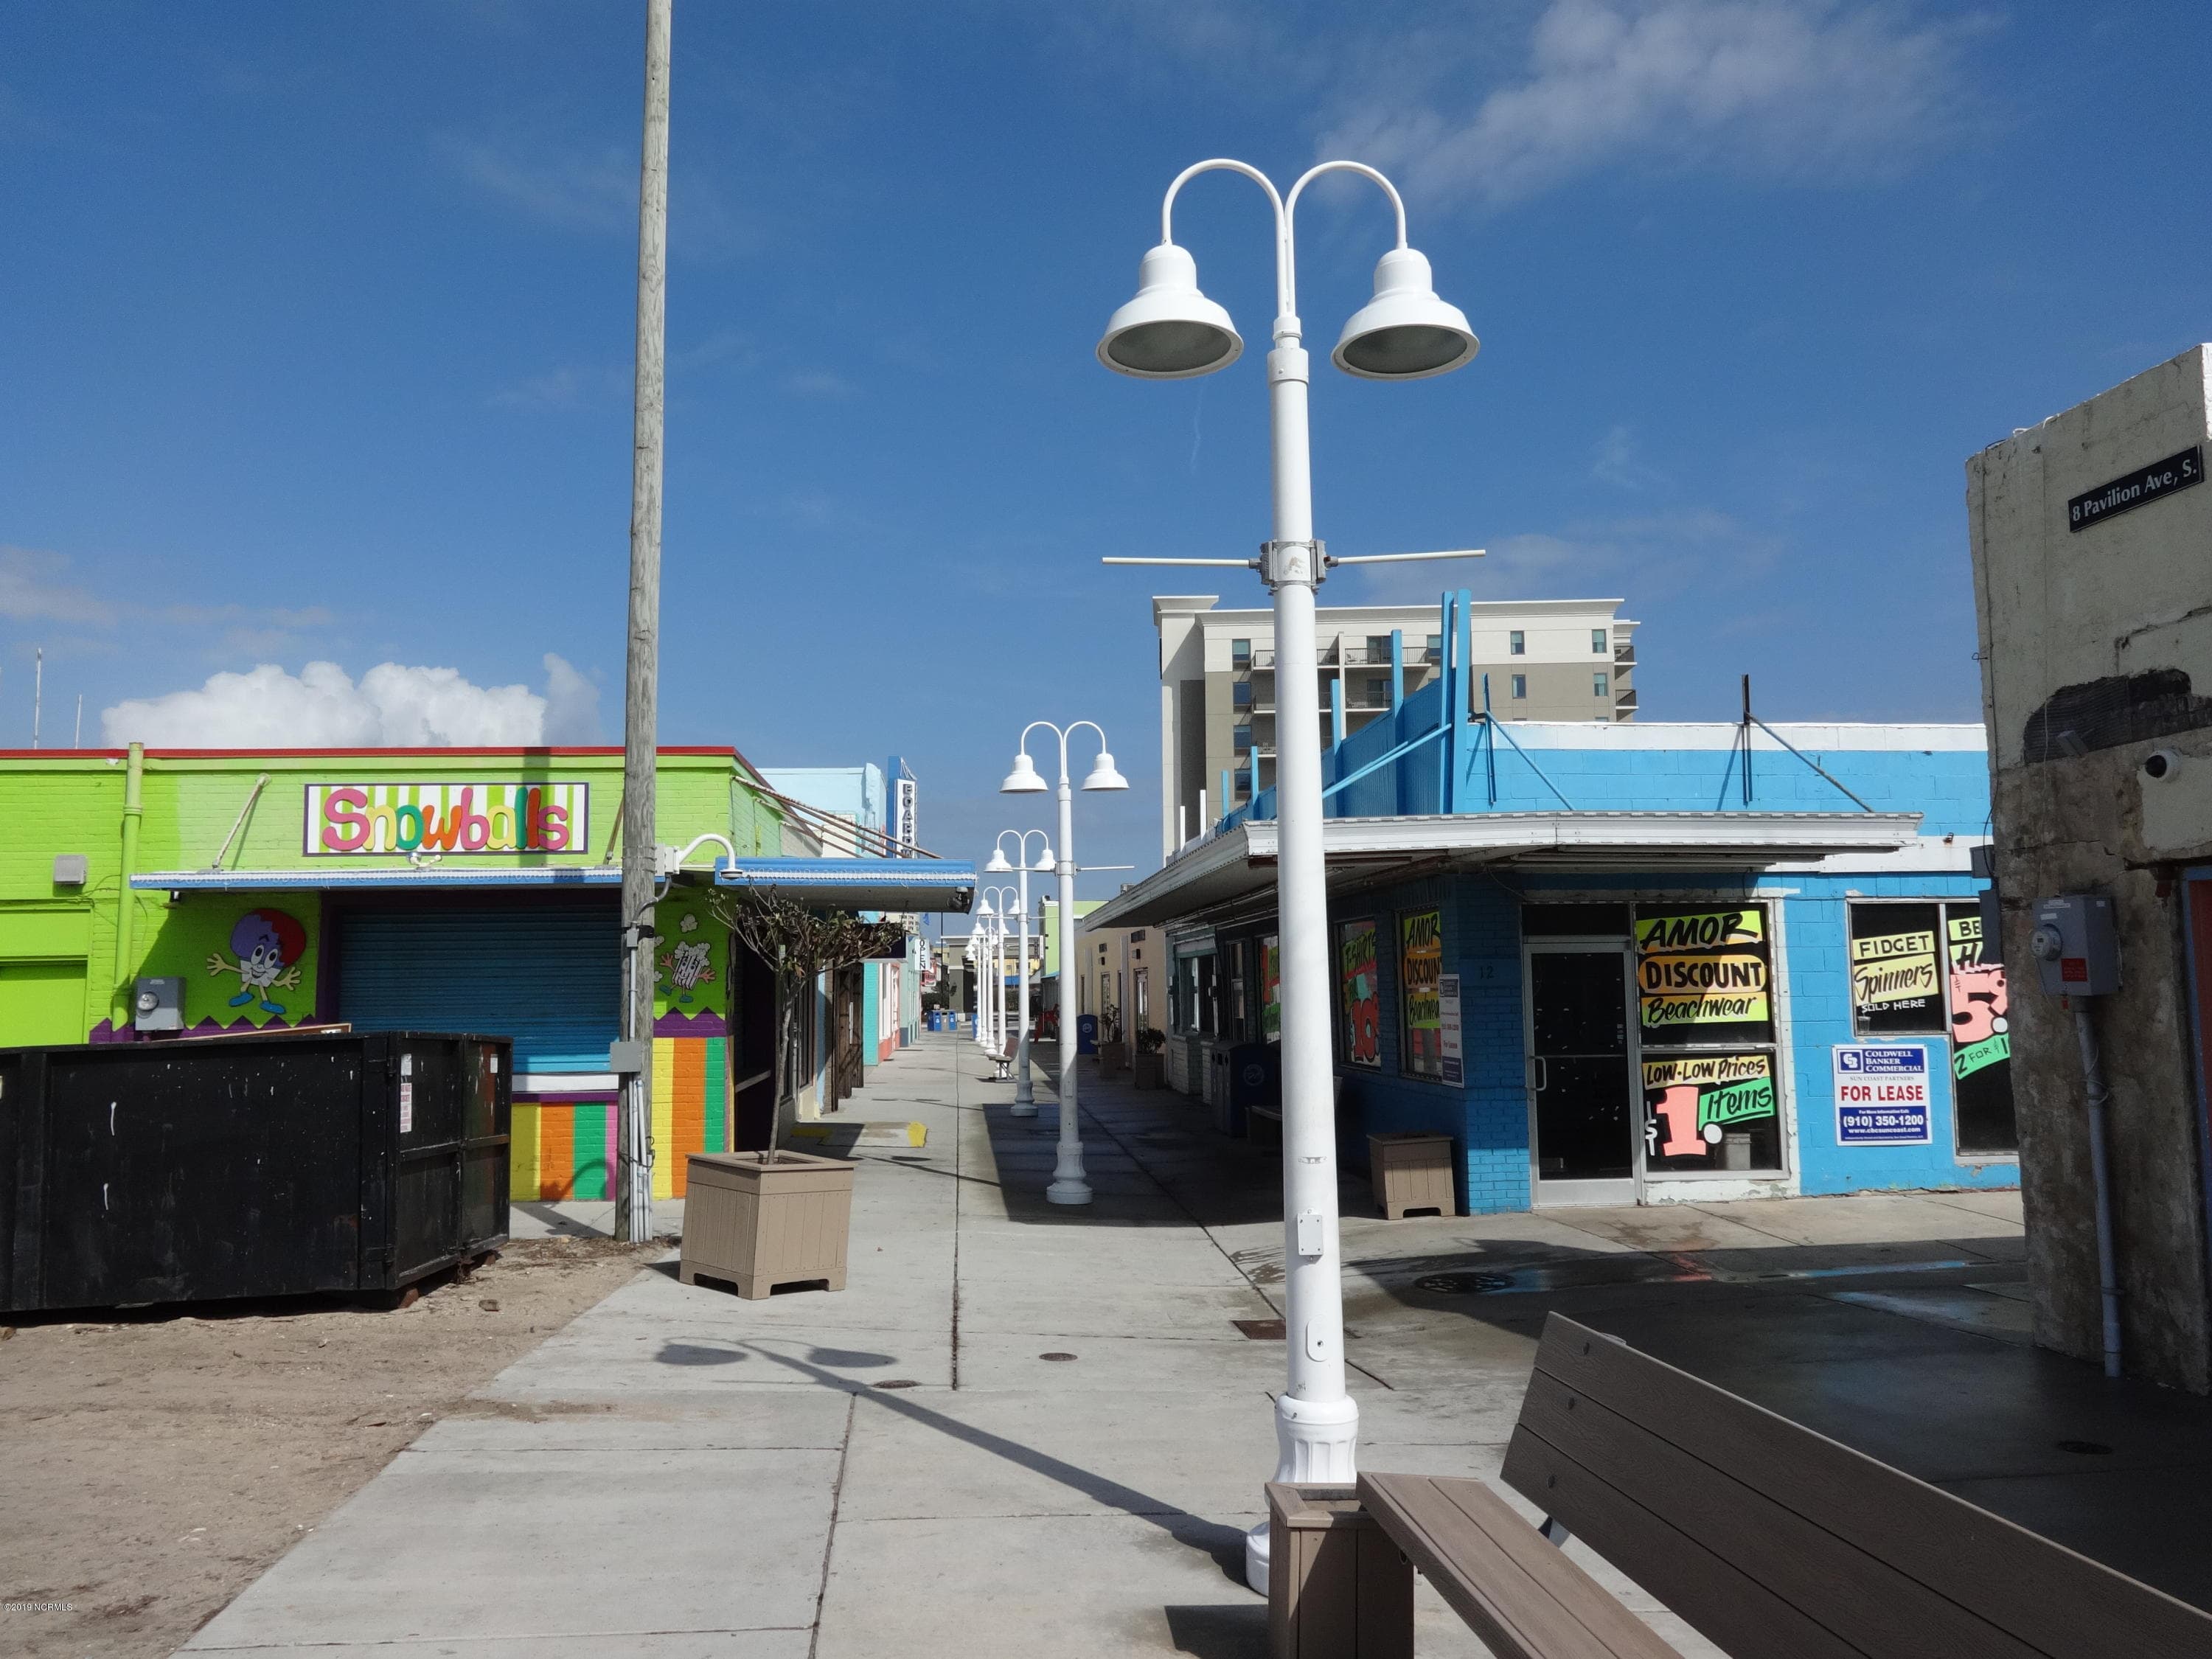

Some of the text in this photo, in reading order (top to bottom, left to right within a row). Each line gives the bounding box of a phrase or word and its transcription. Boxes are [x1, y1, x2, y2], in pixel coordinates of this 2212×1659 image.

[2073, 459, 2197, 521] 8 Pavilion Ave, S.
[322, 787, 569, 850] Snowballs
[1407, 914, 1441, 950] AMOR
[1640, 913, 1759, 951] AMOR
[1859, 935, 1929, 957] FIDGET
[1480, 966, 1494, 980] 12
[1645, 961, 1762, 990] DISCOUNT
[1854, 963, 1933, 1004] Spinners
[1648, 997, 1757, 1024] Beachwear
[1862, 999, 1926, 1013] SOLD HERE
[1718, 1058, 1766, 1079] Prices
[1954, 1054, 1968, 1074] 2
[1969, 1047, 1992, 1062] FOR
[1708, 1087, 1773, 1120] Items
[1840, 1085, 1924, 1101] FOR LEASE
[1843, 1115, 1924, 1127] (910) 350-1200
